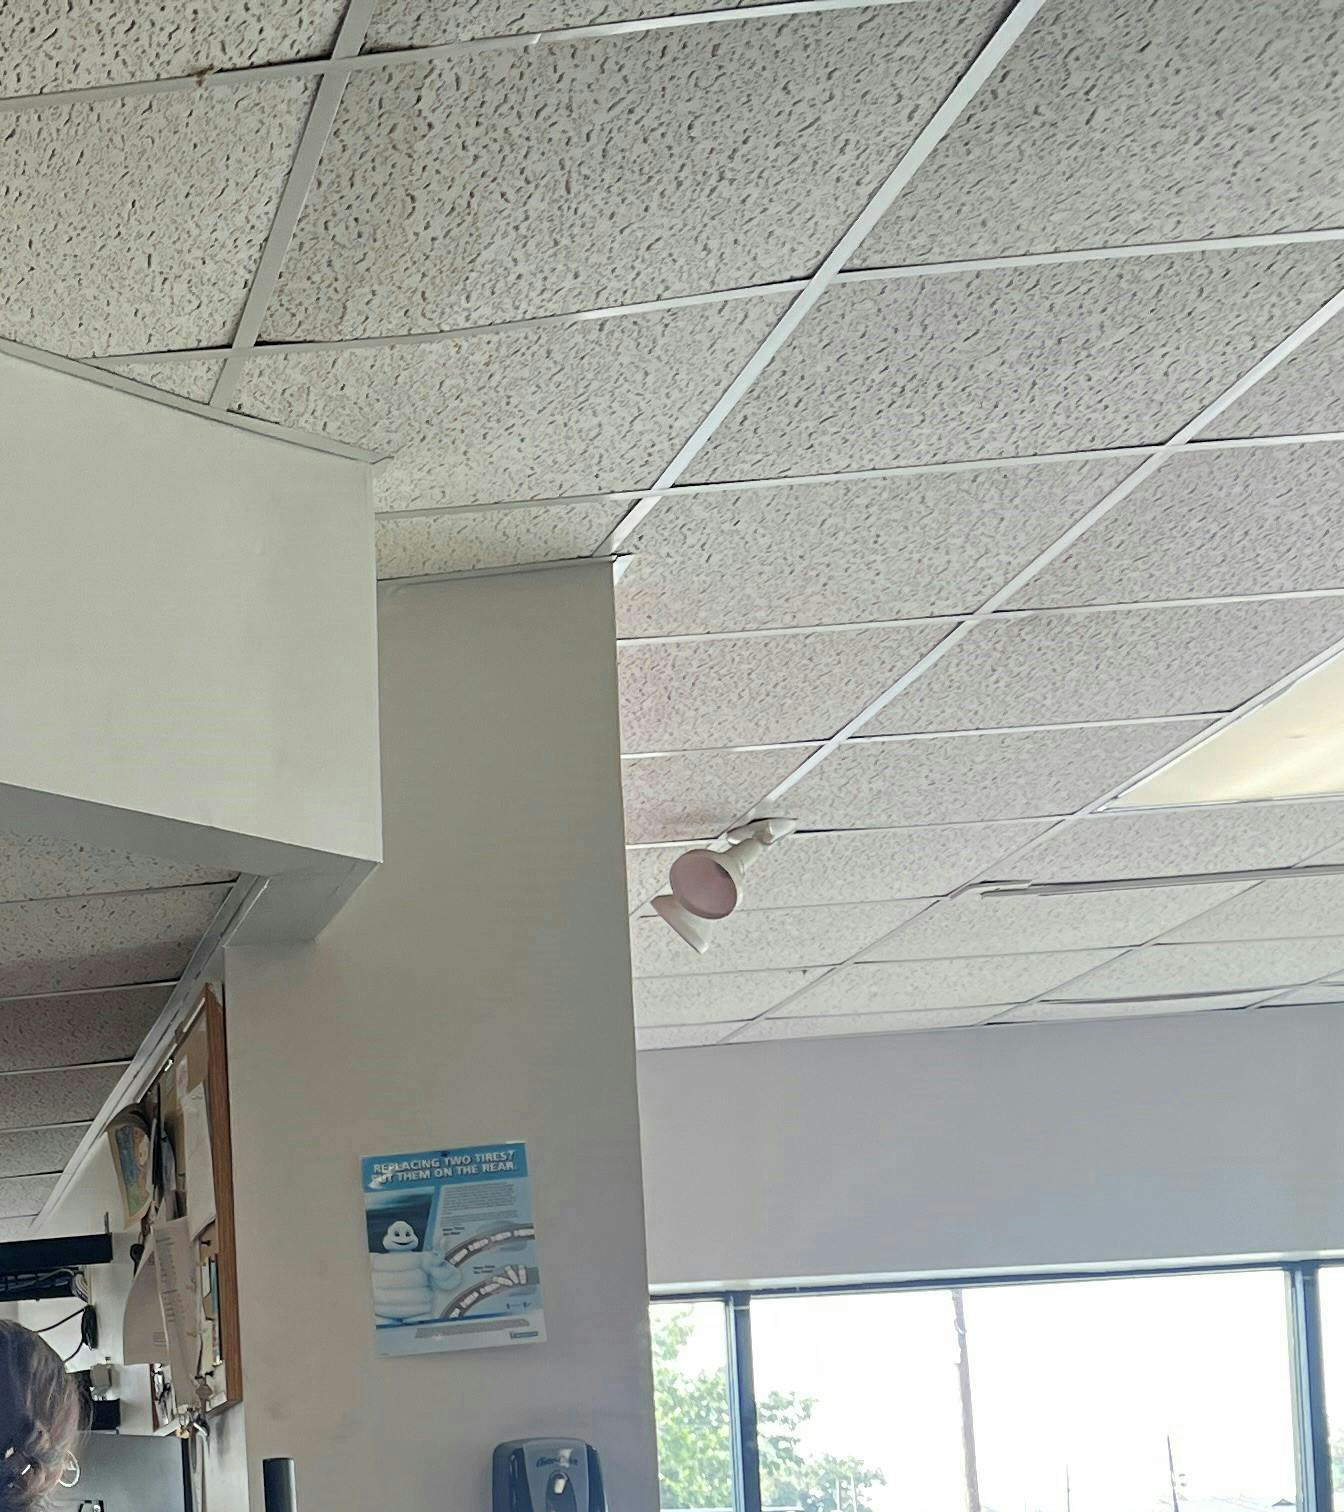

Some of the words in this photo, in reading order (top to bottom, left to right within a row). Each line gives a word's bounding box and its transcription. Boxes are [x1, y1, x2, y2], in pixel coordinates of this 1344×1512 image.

[374, 1158, 440, 1173] REPLACING
[445, 1154, 472, 1167] TWO
[398, 1170, 431, 1182] THEM
[434, 1167, 453, 1178] ON
[457, 1164, 480, 1175] THE
